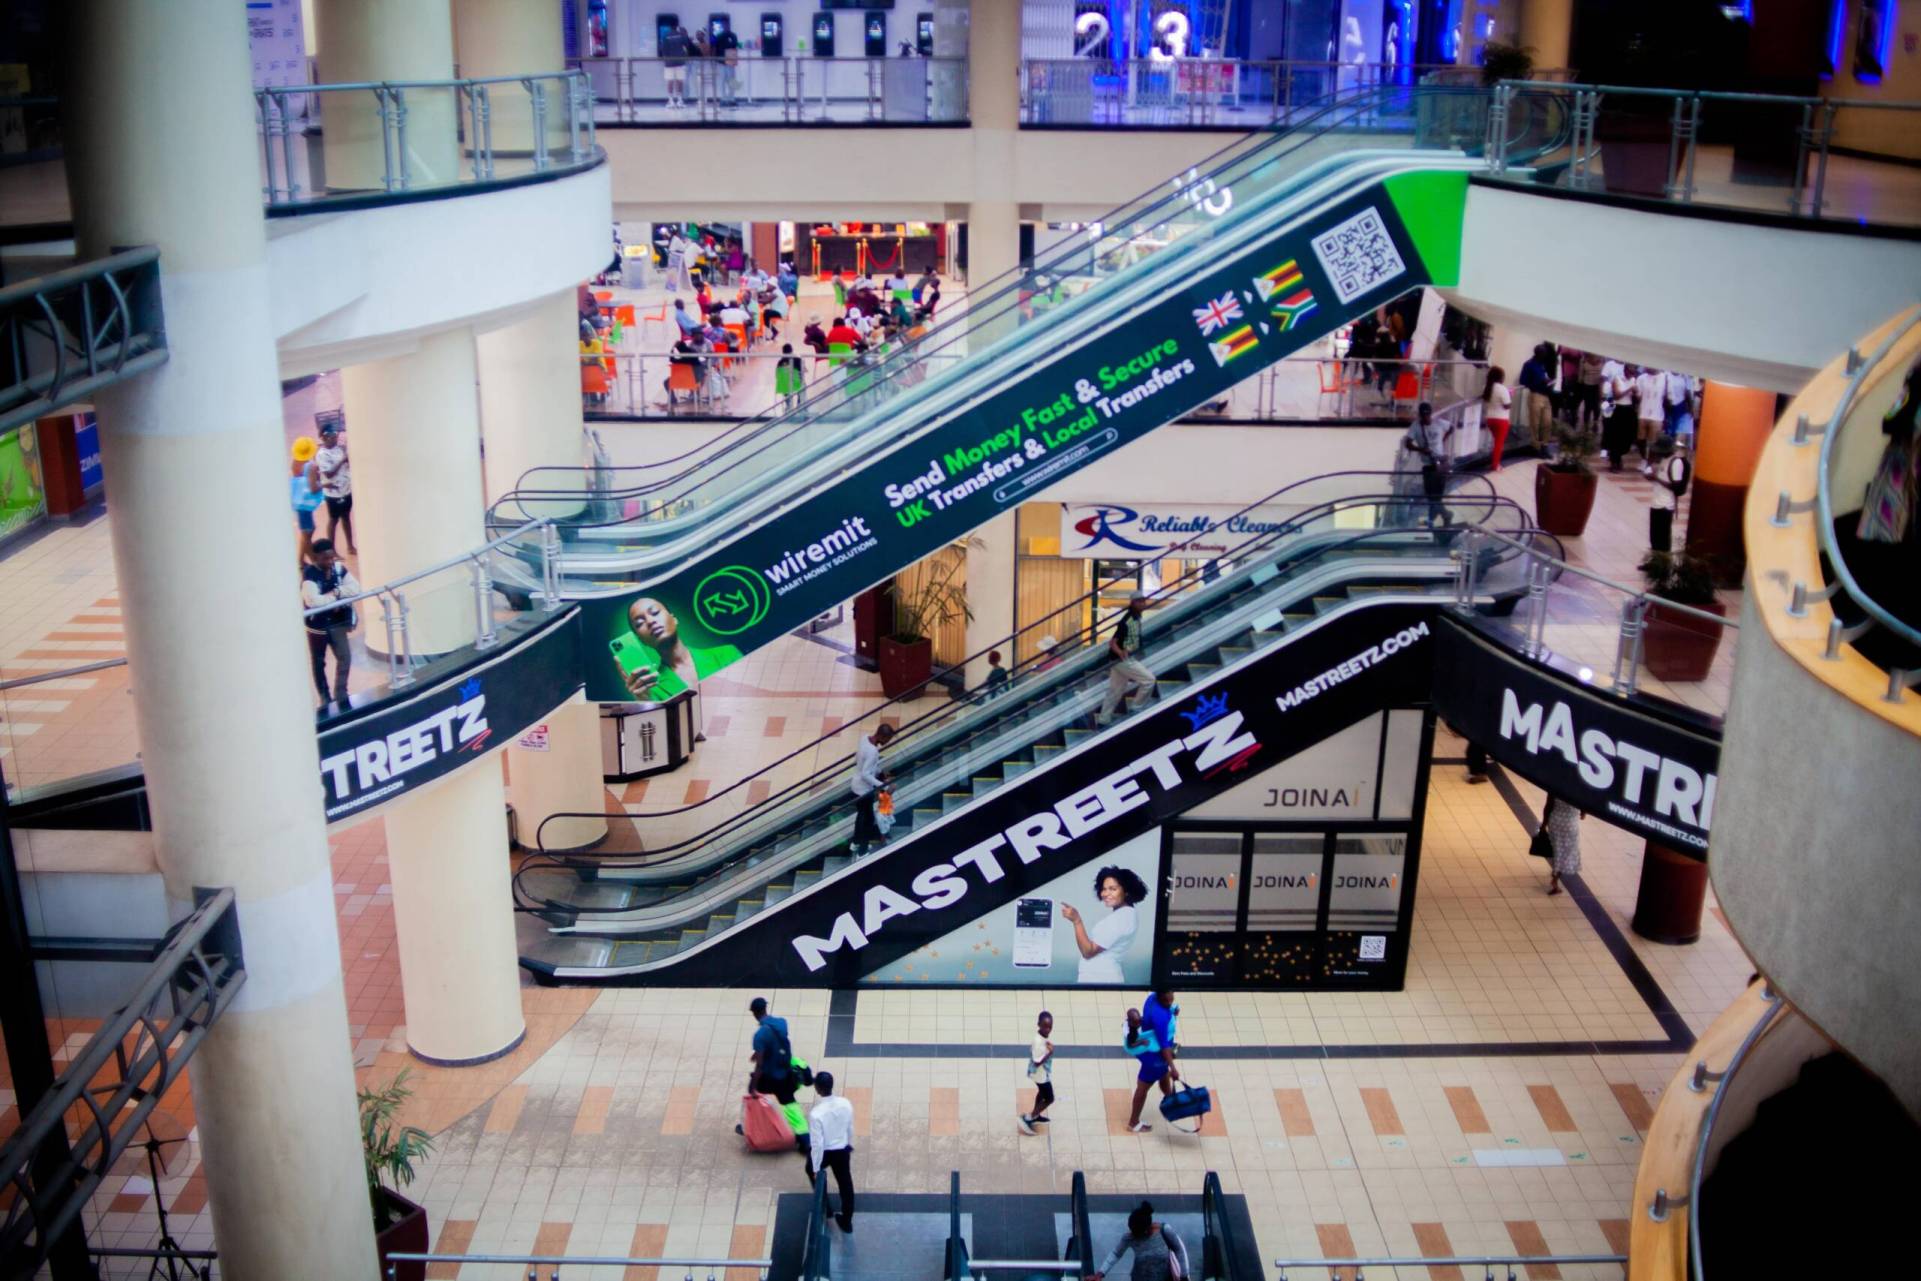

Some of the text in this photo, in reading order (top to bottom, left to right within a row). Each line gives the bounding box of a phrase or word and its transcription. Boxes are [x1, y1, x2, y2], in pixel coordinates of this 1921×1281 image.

[1075, 12, 1110, 57] 2
[1150, 11, 1190, 65] 3
[884, 339, 1178, 508] Send Money Fast & Secure
[896, 358, 1196, 528] UK Transfers & Local Transfers
[764, 516, 872, 584] wiremit
[1139, 515, 1218, 533] Reliable
[776, 537, 879, 596] SMART MONEY SOLUTIONS
[1276, 621, 1431, 712] MASTREETZ.COM
[320, 694, 489, 800] TREETZ
[791, 710, 1257, 972] MASTREETZ
